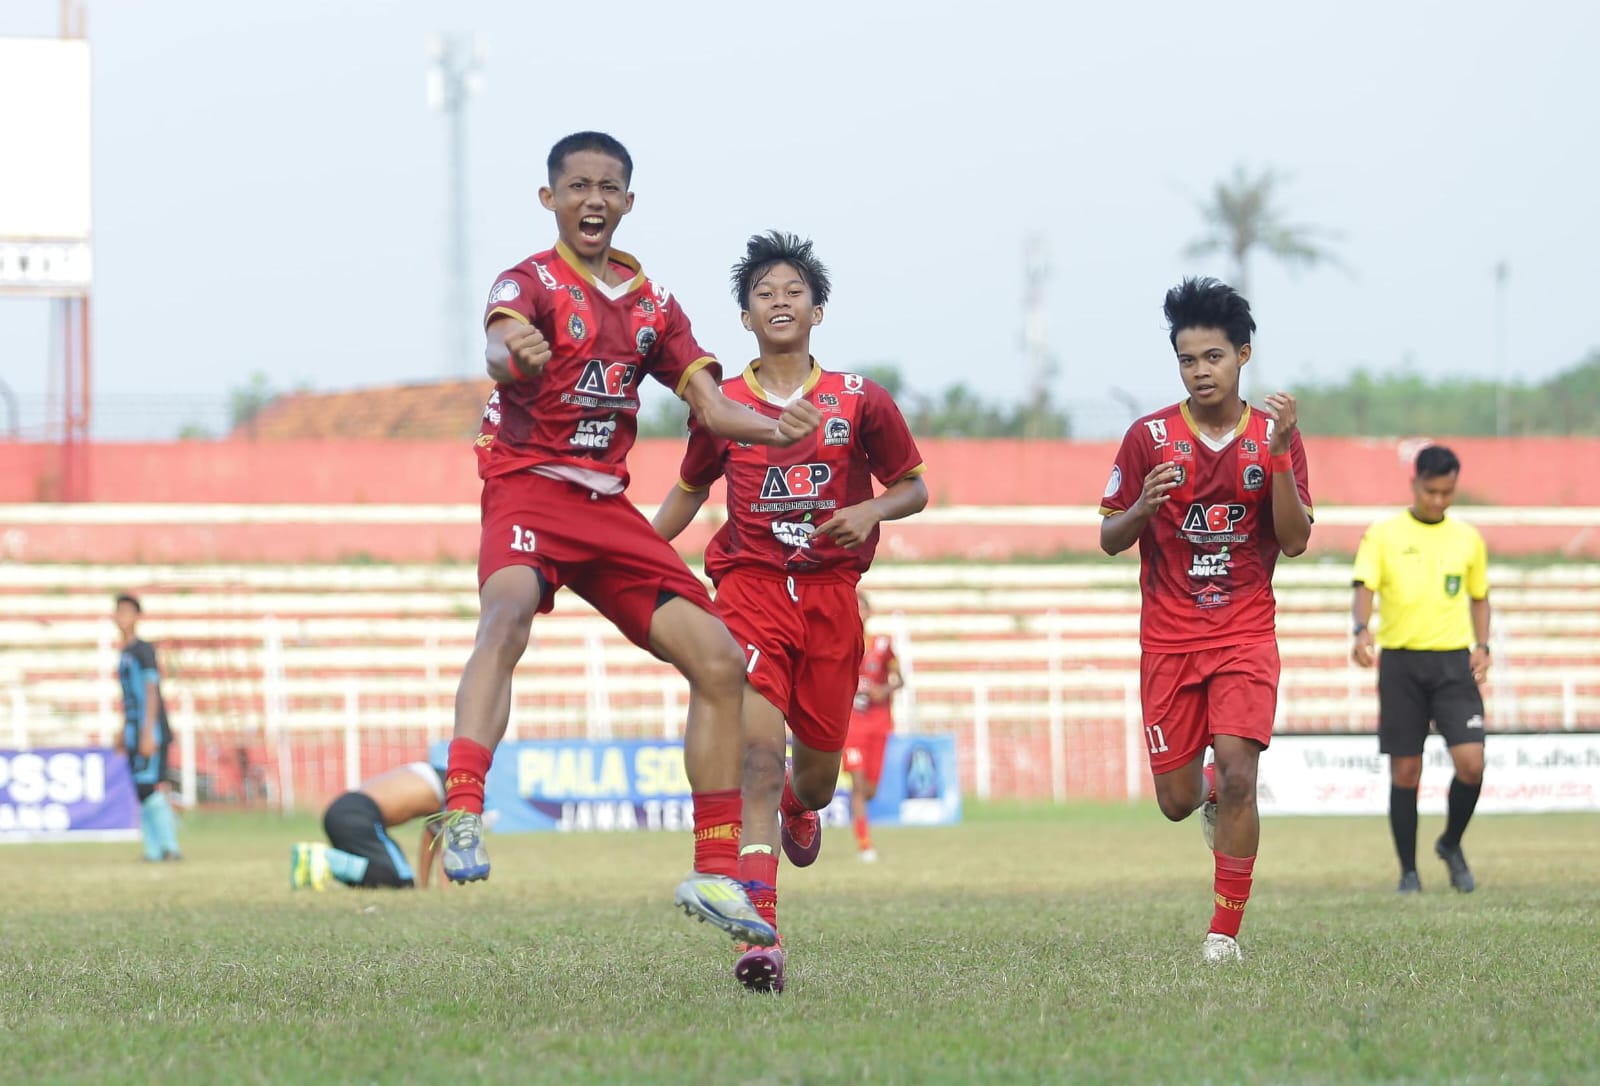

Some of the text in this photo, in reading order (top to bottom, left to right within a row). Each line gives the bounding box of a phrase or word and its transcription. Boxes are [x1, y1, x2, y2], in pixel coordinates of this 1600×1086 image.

[574, 359, 636, 397] ABP
[759, 463, 832, 499] ABP
[1181, 503, 1247, 533] ABP
[510, 524, 536, 552] 13
[1145, 724, 1169, 754] 11
[518, 747, 629, 798] PIALA
[555, 800, 638, 831] JAWA
